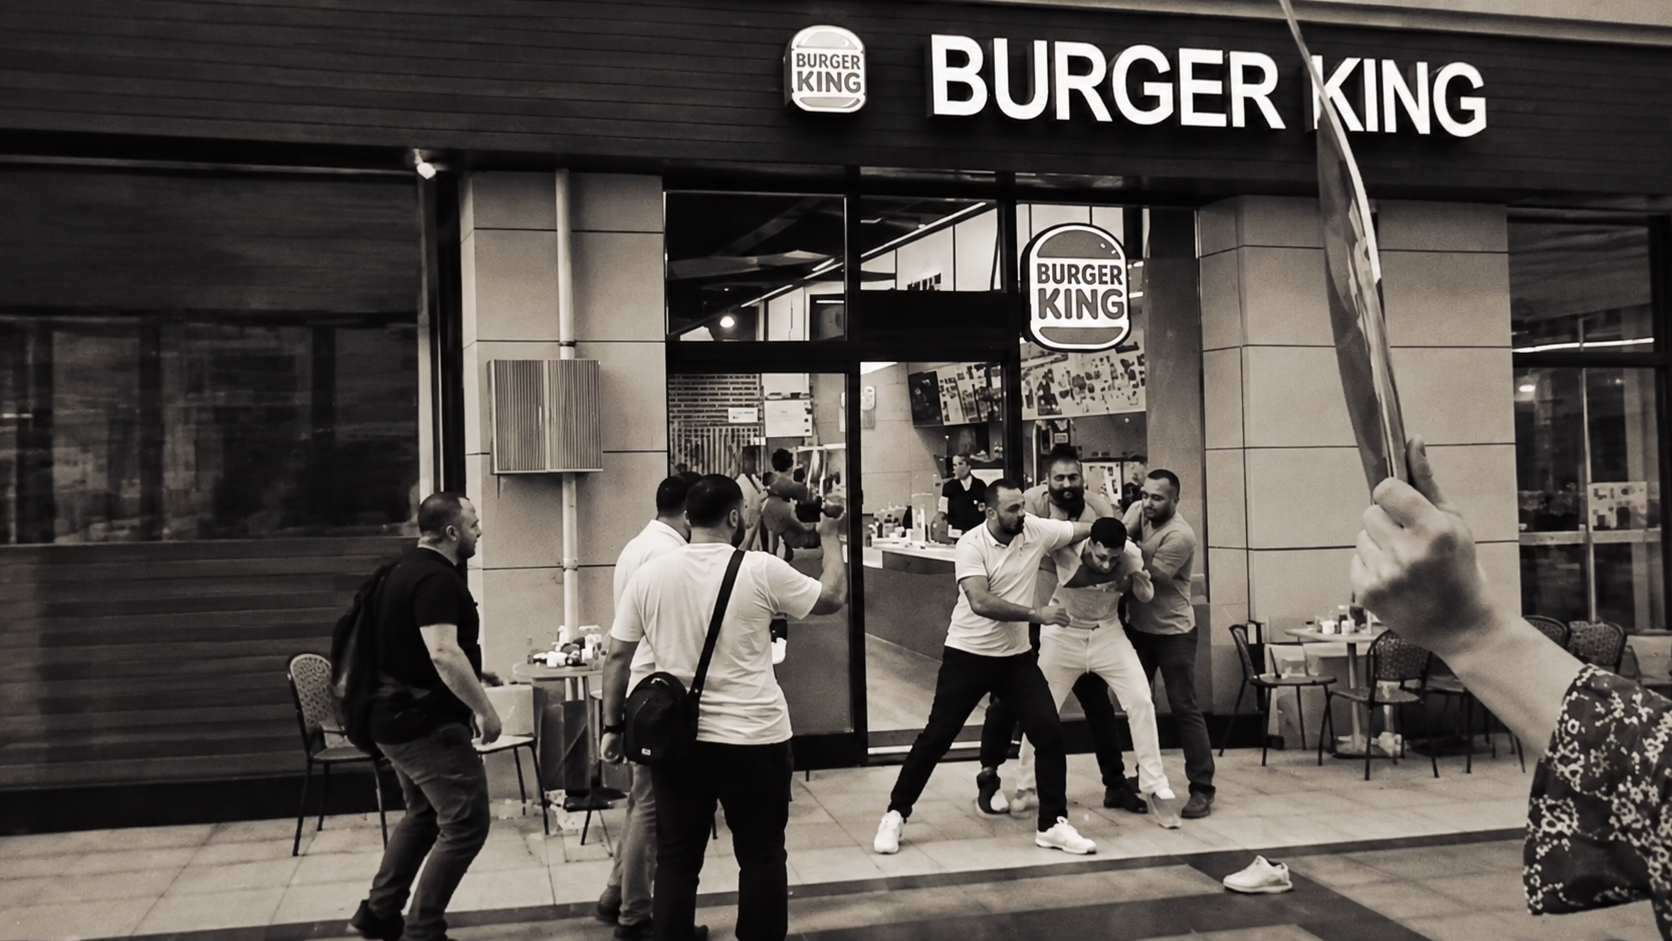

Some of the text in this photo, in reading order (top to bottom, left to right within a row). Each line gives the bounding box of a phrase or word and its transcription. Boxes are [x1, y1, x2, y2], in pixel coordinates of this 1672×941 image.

[796, 53, 861, 70] BURGER
[797, 71, 861, 93] KING
[931, 34, 1487, 138] BURGER KING
[1037, 263, 1123, 285] BURGER
[1038, 288, 1125, 320] KING
